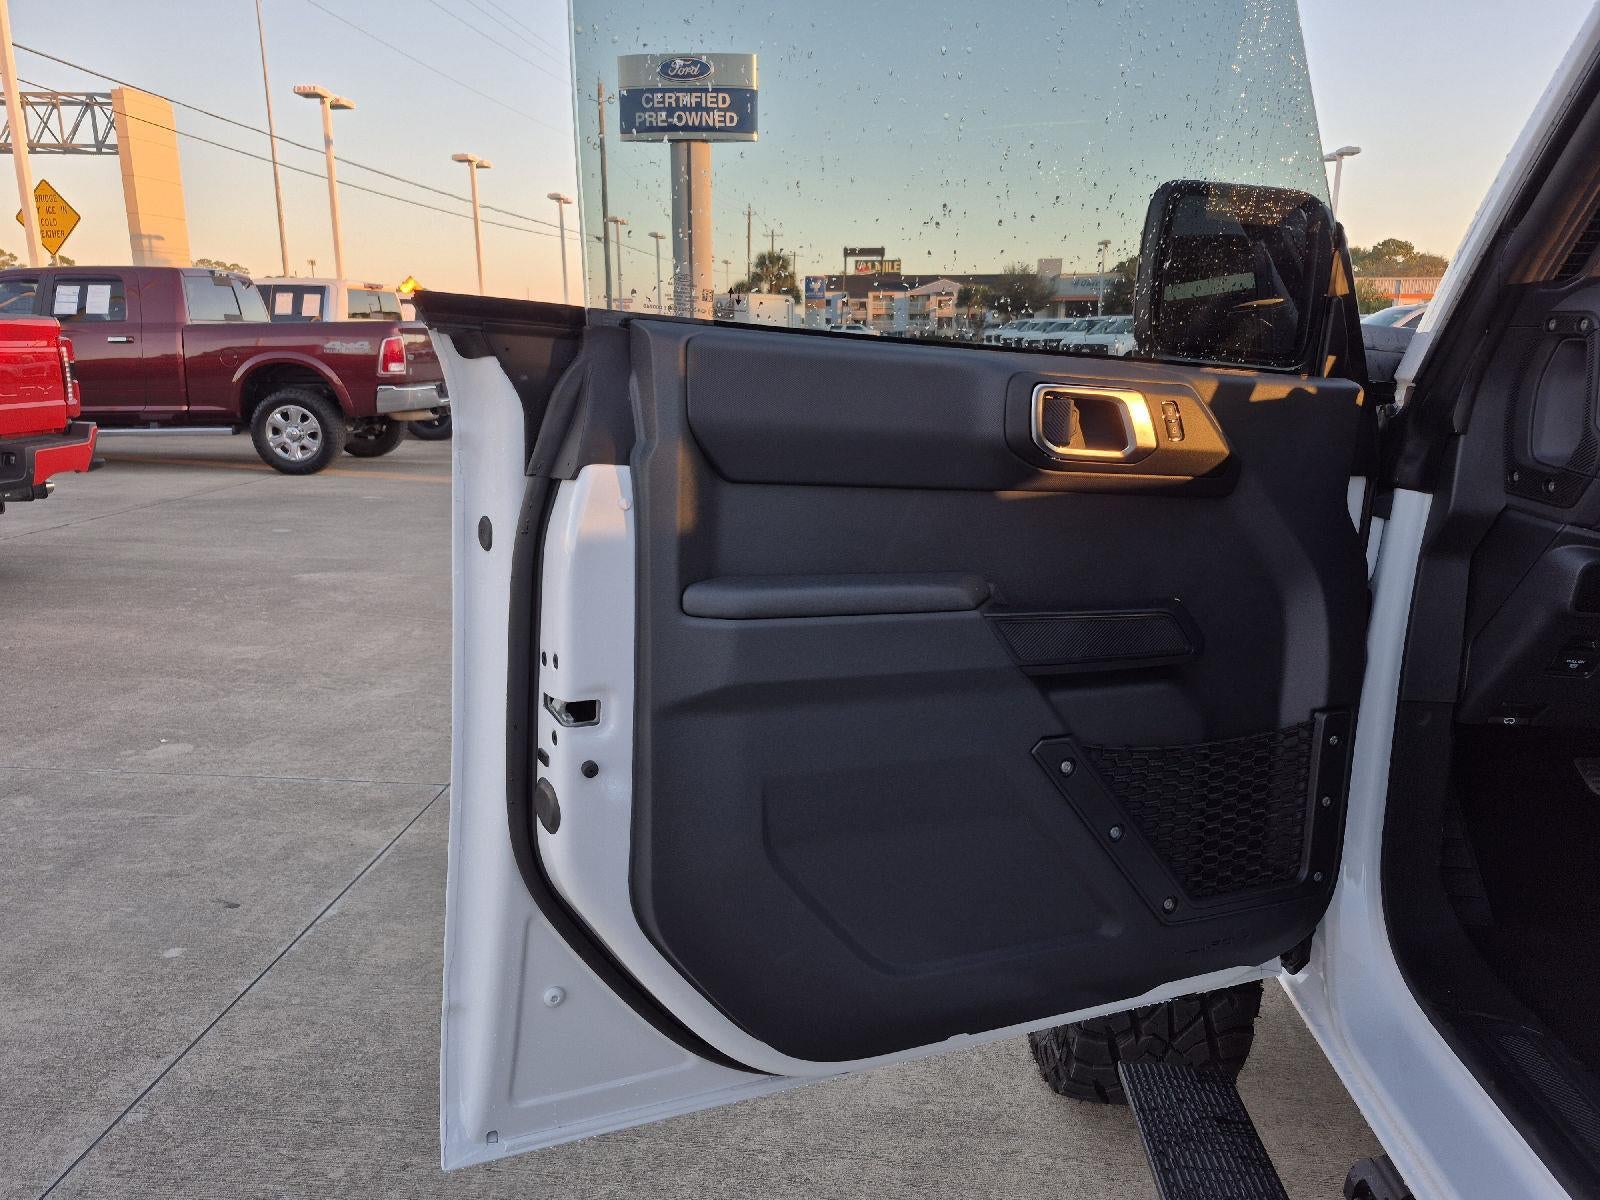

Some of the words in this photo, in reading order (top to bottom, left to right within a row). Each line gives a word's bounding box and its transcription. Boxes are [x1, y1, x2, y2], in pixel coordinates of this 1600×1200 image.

[668, 59, 701, 76] Ford
[641, 92, 731, 108] CERTIFIED
[635, 111, 738, 127] PRE-OWNED
[41, 229, 65, 239] EATHER
